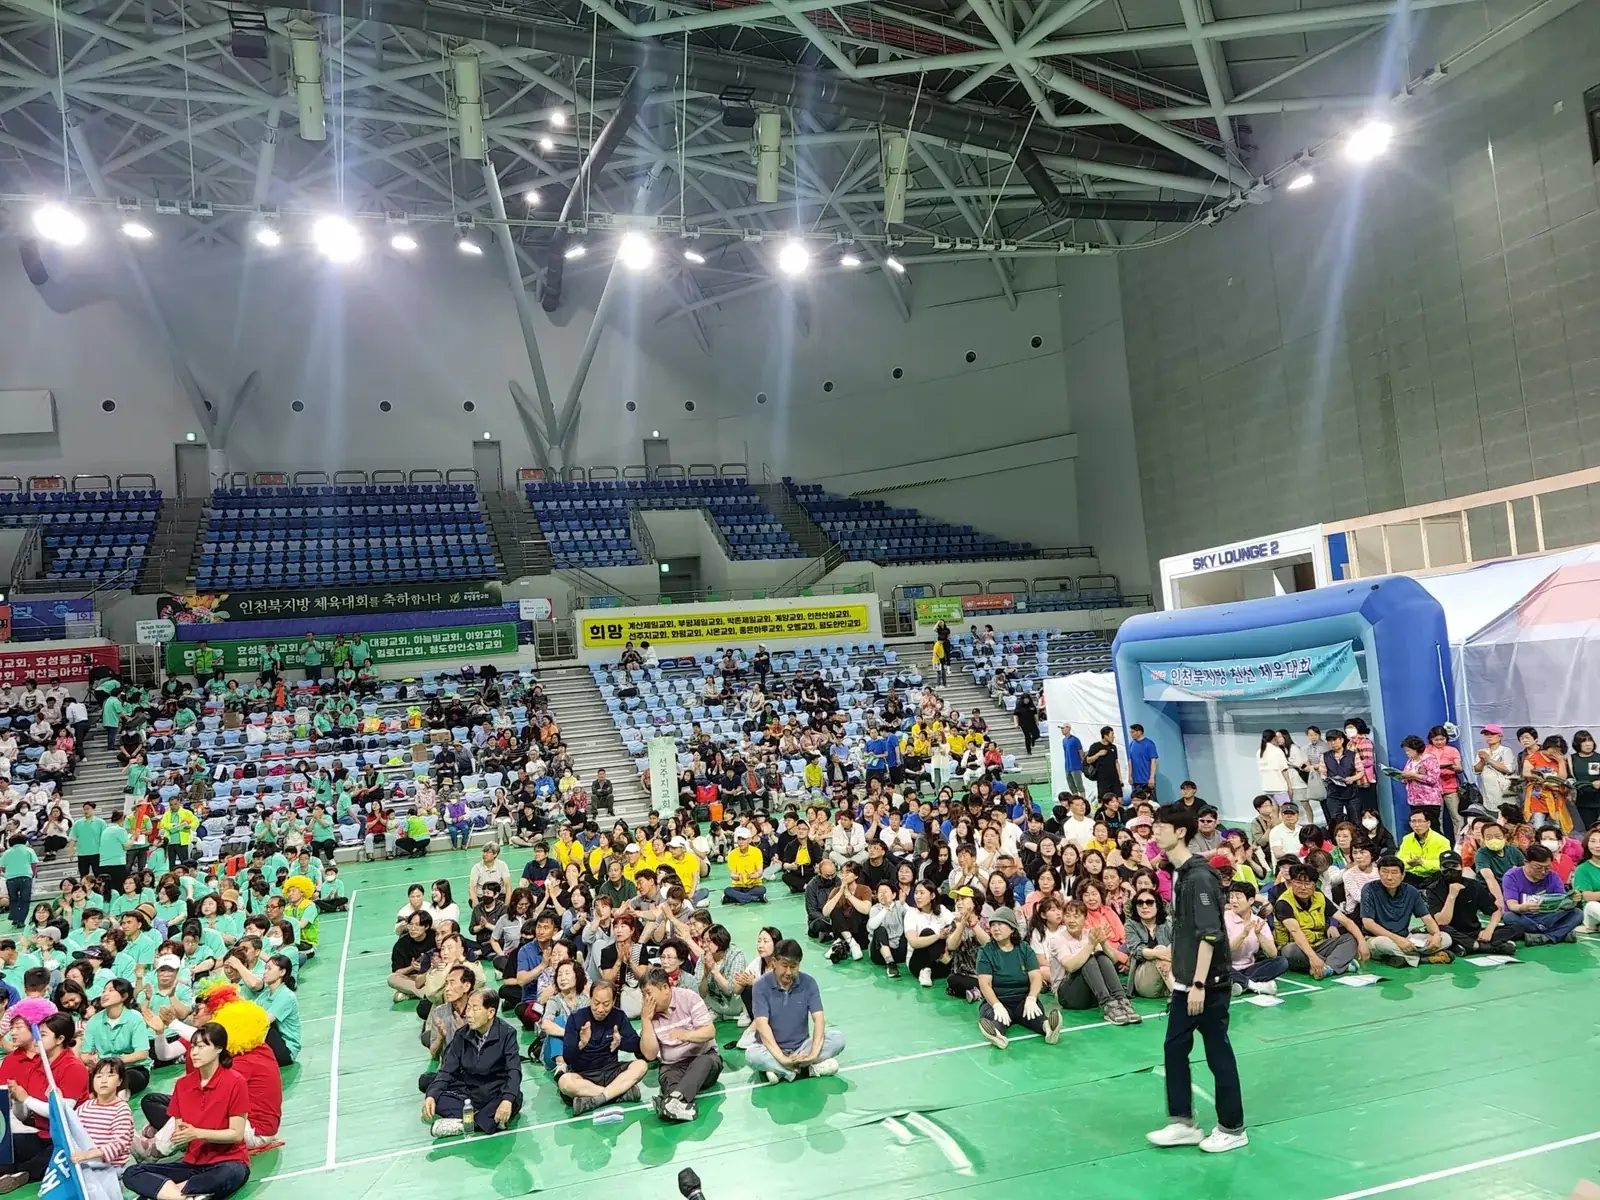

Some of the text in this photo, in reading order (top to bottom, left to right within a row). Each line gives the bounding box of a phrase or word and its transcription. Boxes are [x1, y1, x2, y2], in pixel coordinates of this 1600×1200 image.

[1193, 540, 1280, 570] SKY LOUNGE 2
[239, 592, 442, 615] 인천북지방 체육대회를 축하합니다
[628, 619, 677, 631] 계산제일교회,
[678, 617, 725, 628] 부평제일교회,
[775, 613, 805, 623] 계양교회,
[369, 636, 411, 647] 대광교회,
[413, 632, 463, 645] 하늘빛교회,
[465, 629, 505, 641] 이화교회,
[590, 624, 623, 640] 희망
[628, 631, 670, 641] 선주지교회,
[706, 627, 738, 637] 시온교회,
[0, 657, 31, 669] 교회,
[1170, 667, 1228, 687] 인천북지방
[1229, 664, 1256, 684] 친선
[1258, 656, 1314, 681] 체육대회
[659, 757, 671, 809] 선주지교회
